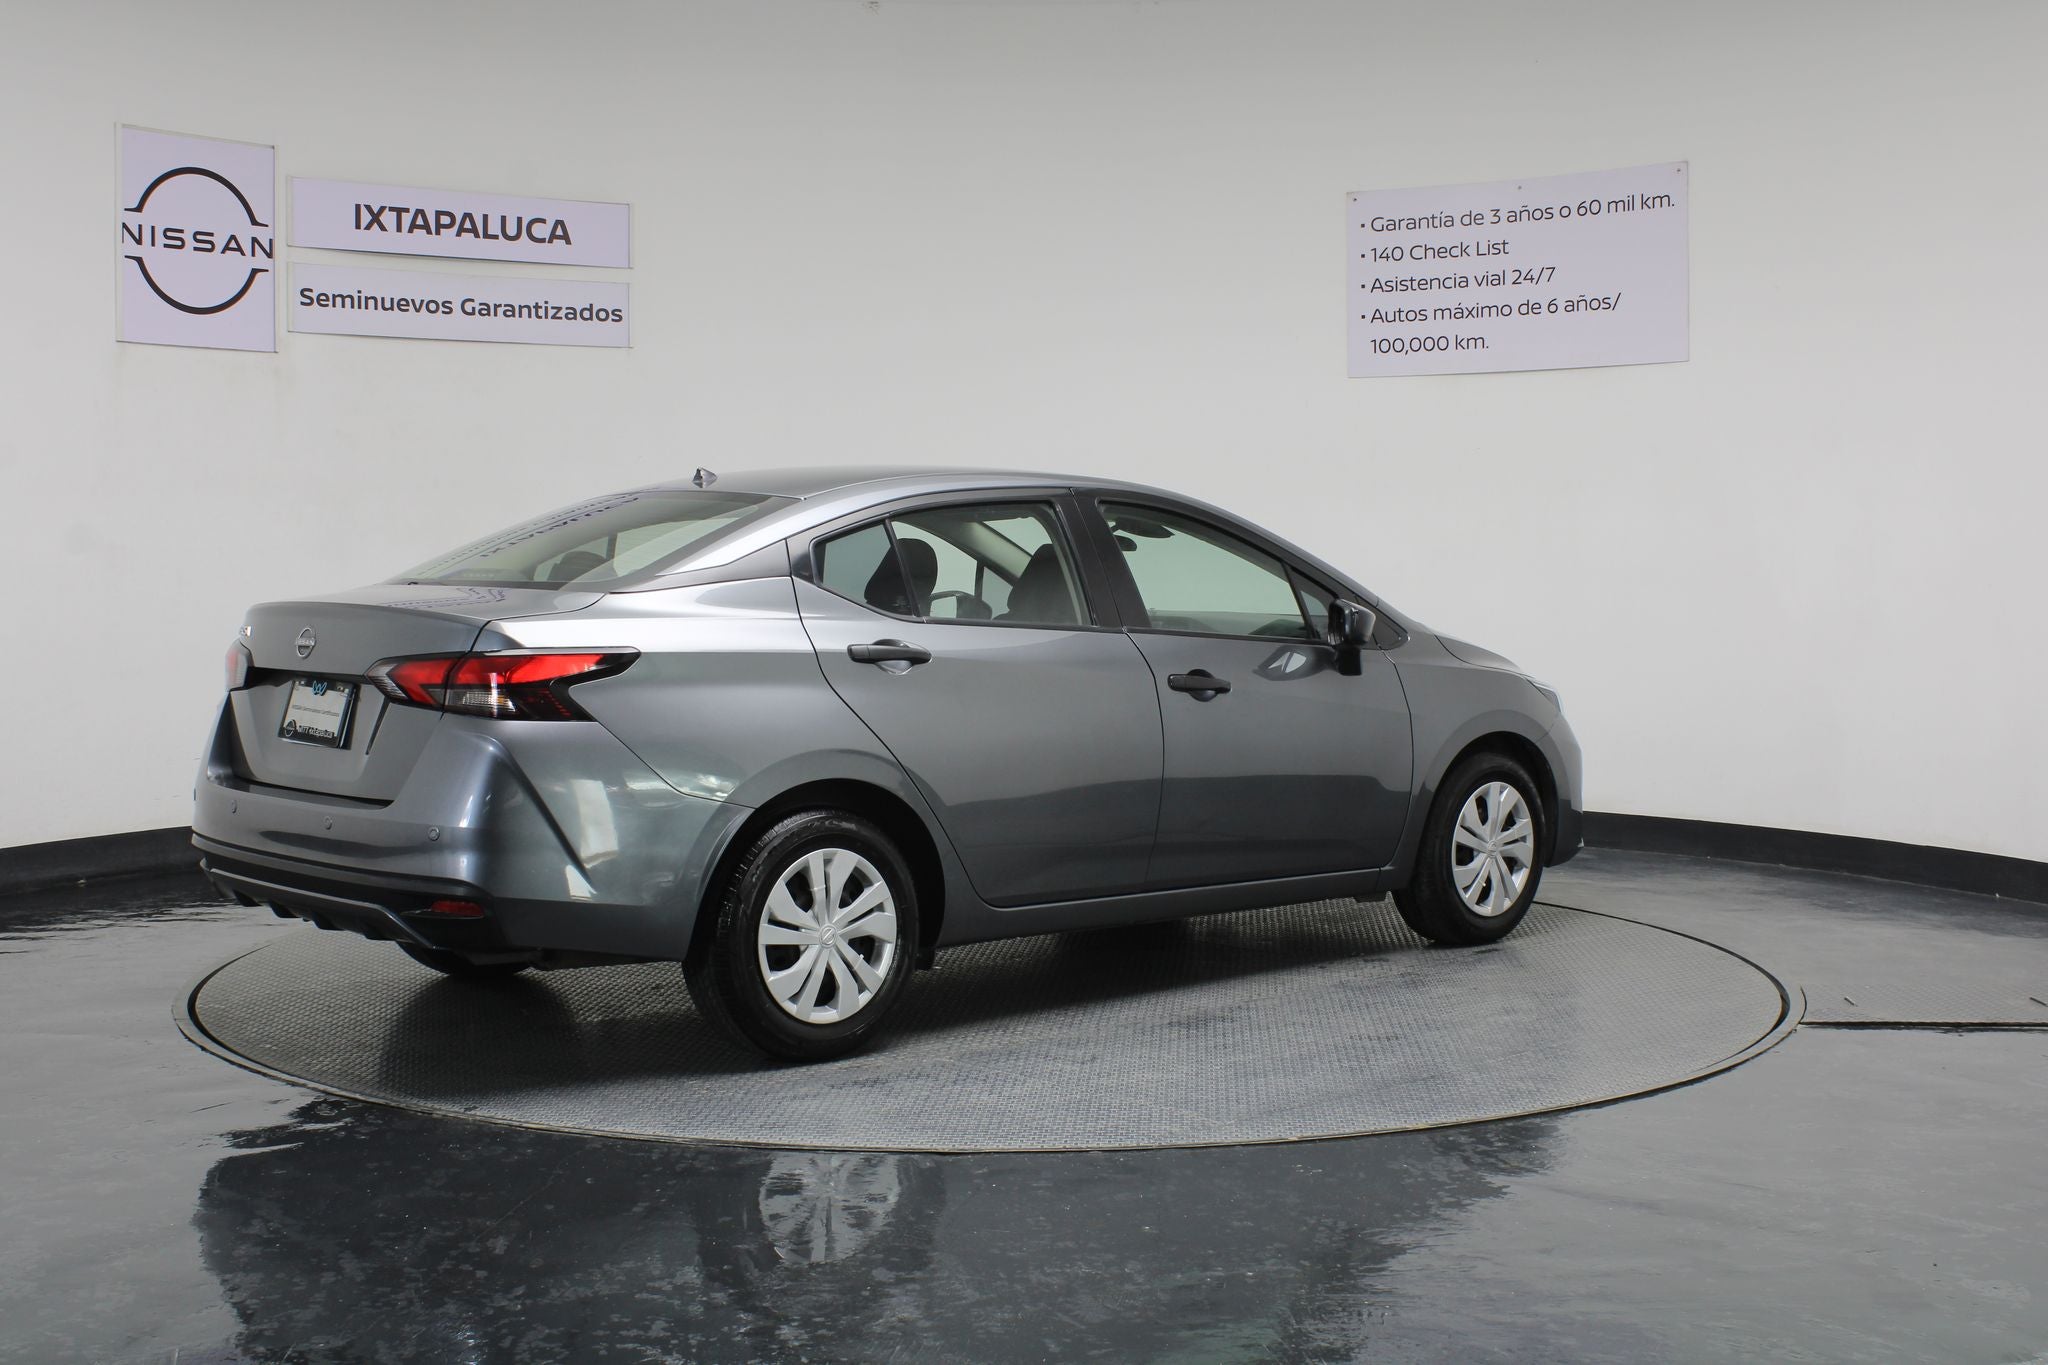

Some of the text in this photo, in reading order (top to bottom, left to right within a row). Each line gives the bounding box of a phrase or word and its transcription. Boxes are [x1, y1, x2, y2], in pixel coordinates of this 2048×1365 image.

[354, 203, 572, 246] IXTAPALUCA
[1370, 193, 1676, 233] Garantía de 3 años o 60 mil km.
[121, 221, 274, 260] NISSAN
[1370, 239, 1510, 263] 140 Check List
[1370, 266, 1556, 294] Asistencia vial 24/7
[299, 287, 623, 323] Seminuevos Garantizados
[1370, 292, 1622, 324] Autos máximo de 6 años/
[1370, 334, 1490, 356] 100,000 km.
